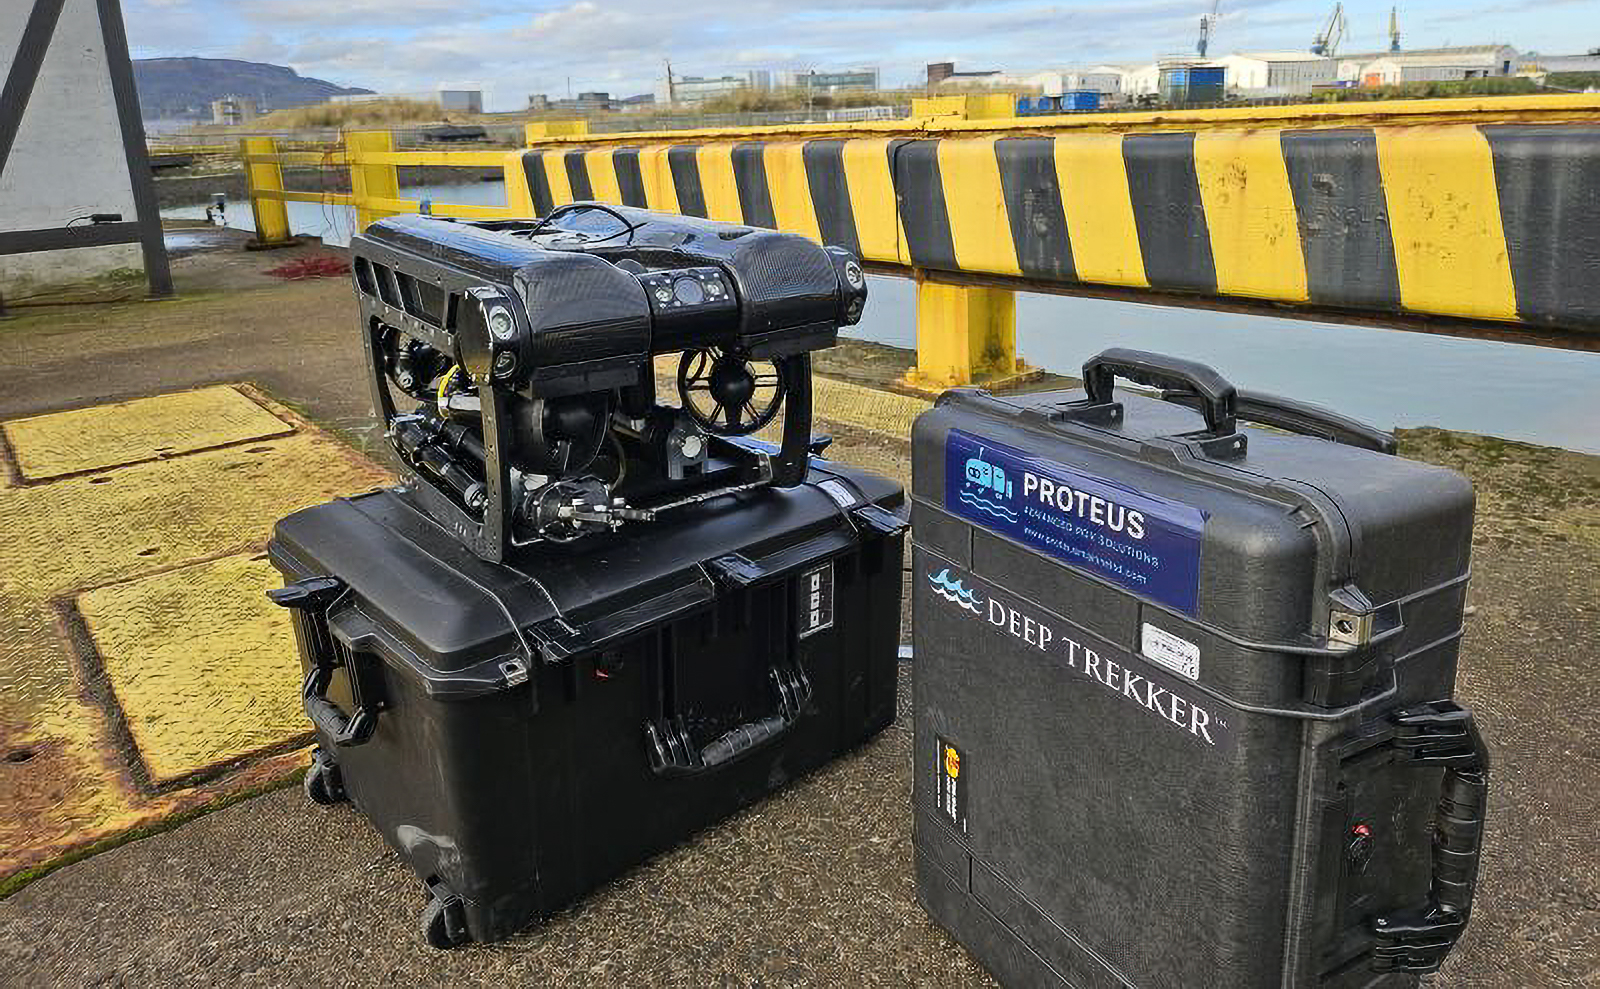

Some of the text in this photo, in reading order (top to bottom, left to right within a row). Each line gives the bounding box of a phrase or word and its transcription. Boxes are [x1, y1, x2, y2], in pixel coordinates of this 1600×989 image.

[1023, 472, 1145, 539] PROTEUS
[988, 597, 1052, 651] DEEP
[1061, 636, 1215, 746] TREKKER
